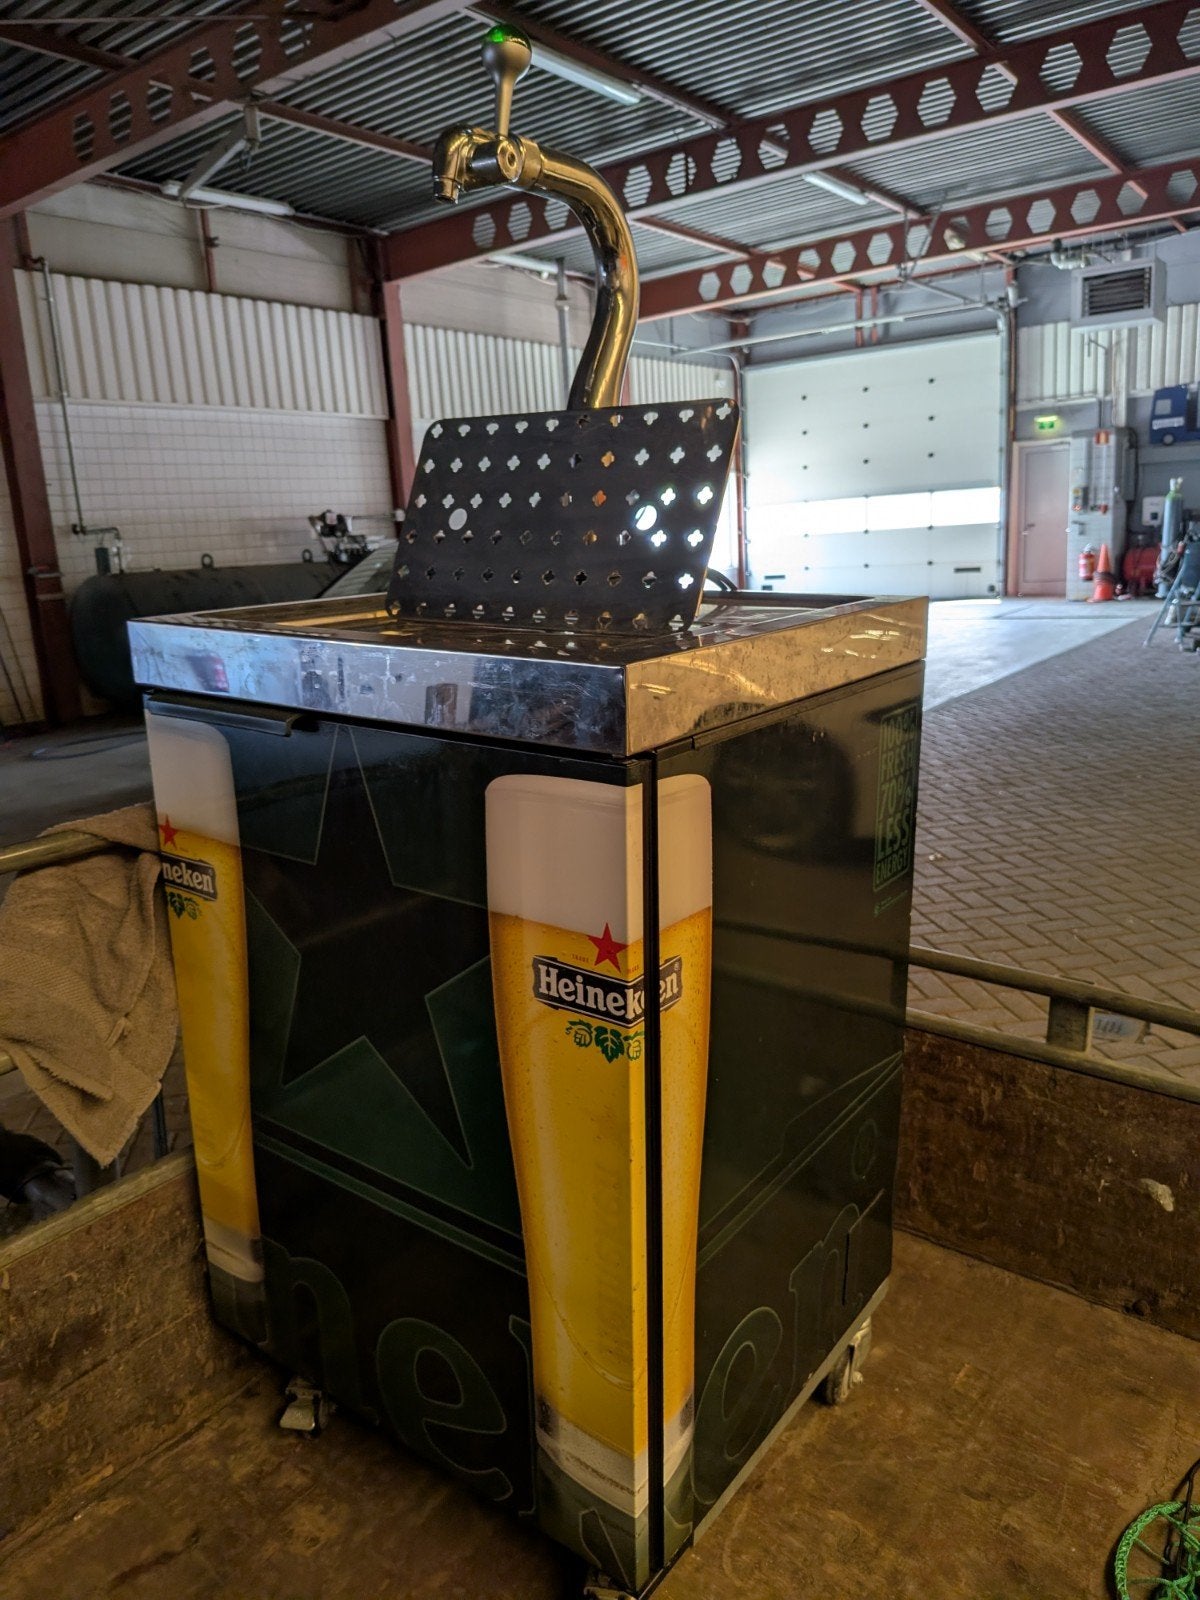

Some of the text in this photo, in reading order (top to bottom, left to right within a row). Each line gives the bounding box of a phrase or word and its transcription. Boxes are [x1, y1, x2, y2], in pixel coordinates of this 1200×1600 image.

[881, 742, 915, 782] FRESH
[880, 771, 912, 822] 70%
[878, 810, 910, 859] LESS
[876, 847, 909, 885] ENERGY
[538, 963, 678, 1018] Heineken
